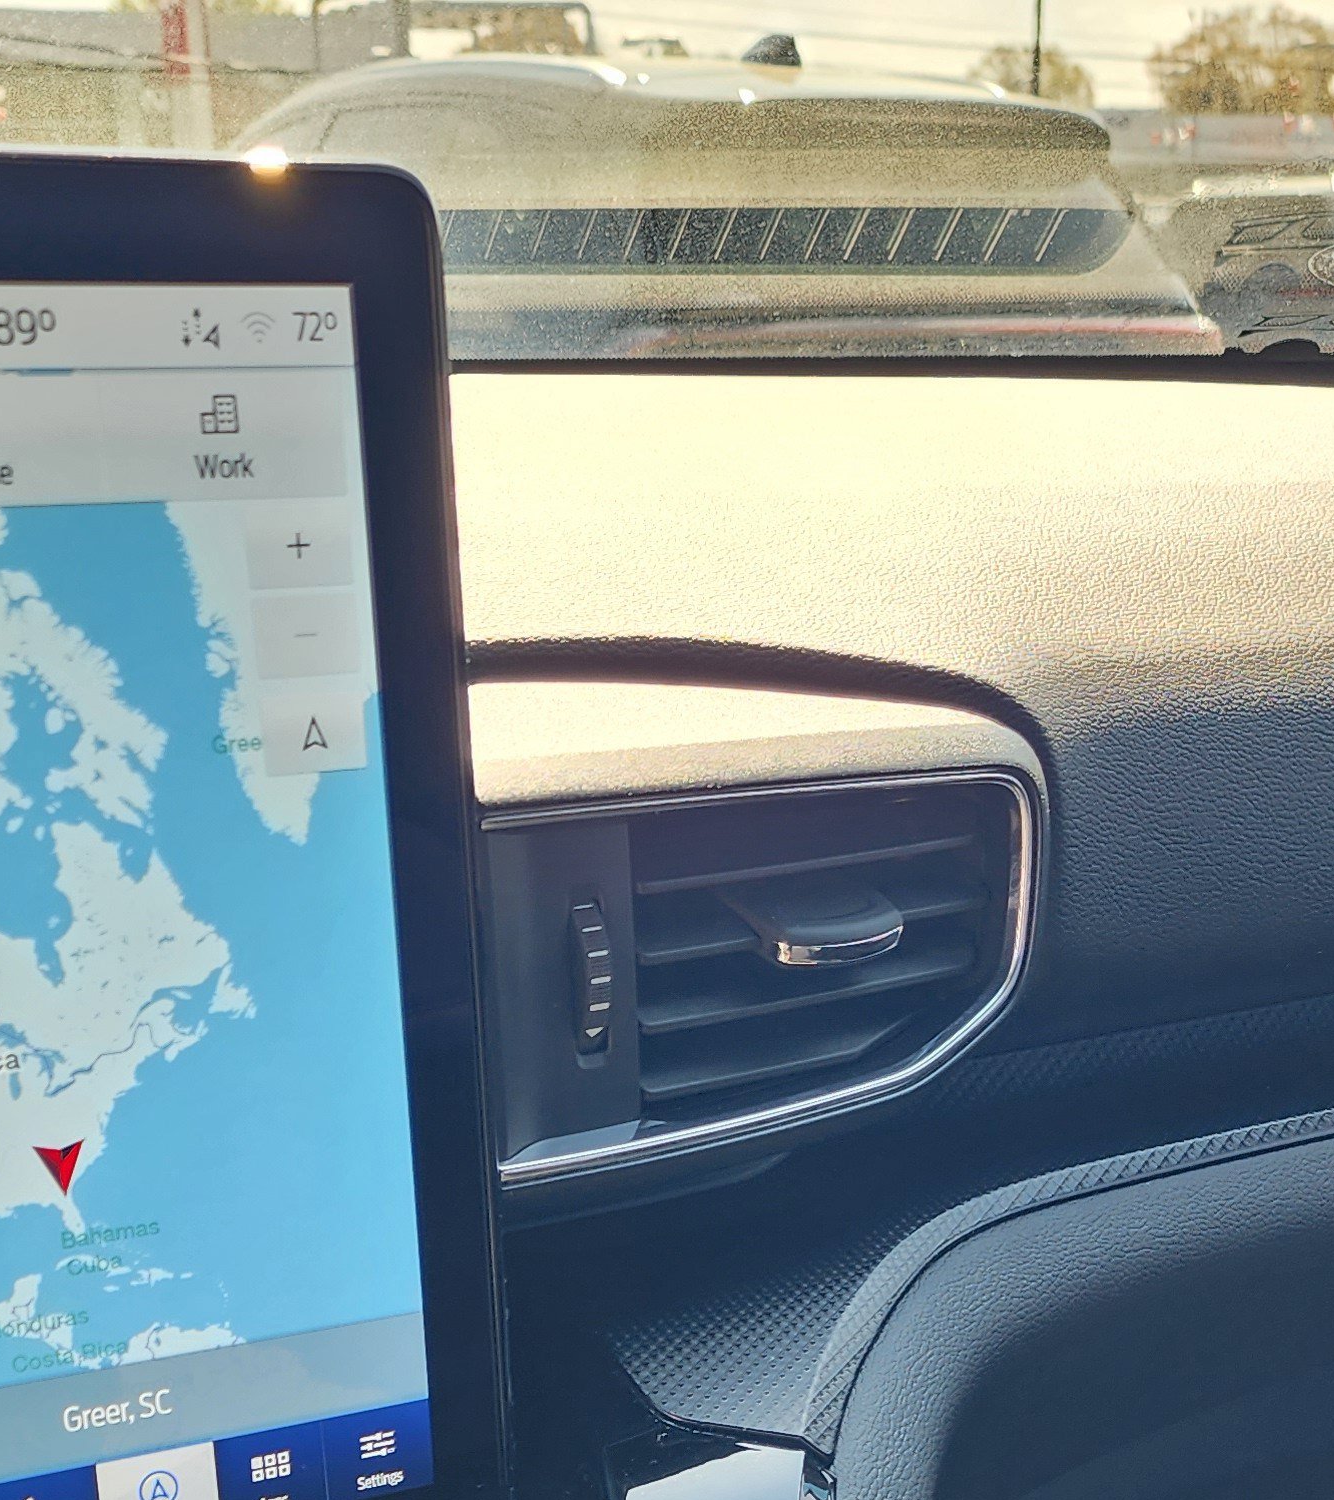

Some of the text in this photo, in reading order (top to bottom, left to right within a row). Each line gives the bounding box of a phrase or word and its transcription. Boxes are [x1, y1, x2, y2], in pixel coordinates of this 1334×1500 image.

[194, 452, 255, 481] Work
[60, 1219, 161, 1249] Bahamas
[67, 1253, 123, 1276] Cuba
[62, 1388, 173, 1433] Greer, SC
[356, 1468, 405, 1492] Settings
